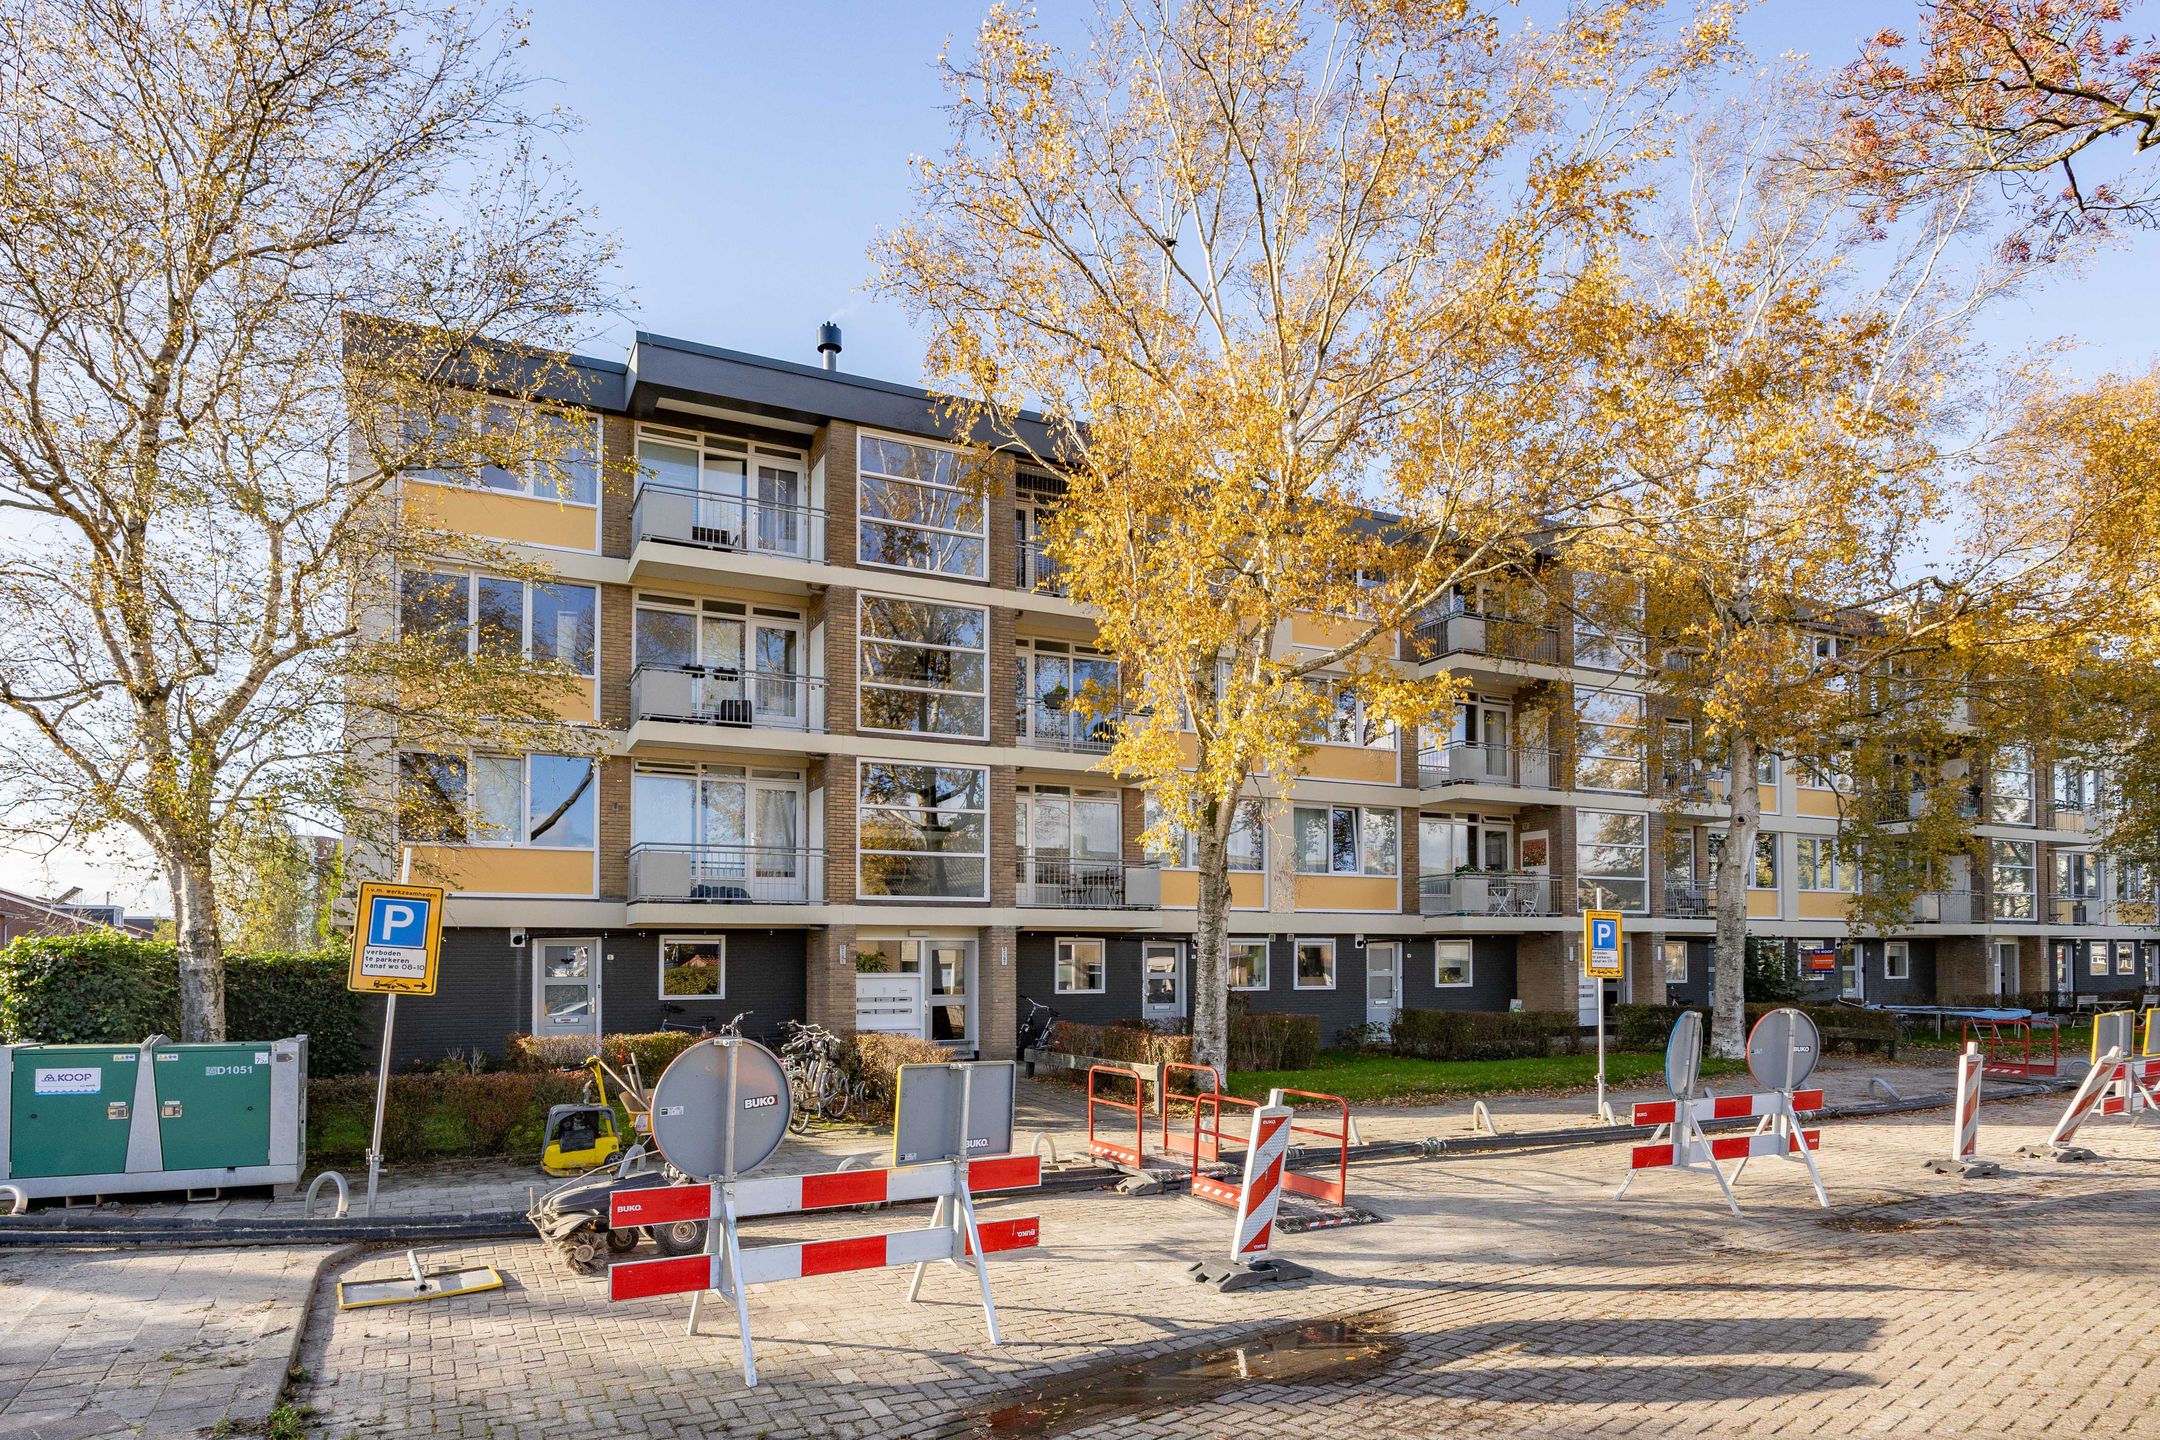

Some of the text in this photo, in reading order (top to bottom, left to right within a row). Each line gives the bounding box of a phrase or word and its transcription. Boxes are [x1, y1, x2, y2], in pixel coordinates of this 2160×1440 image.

[382, 904, 414, 940] P
[1597, 923, 1611, 946] P
[366, 949, 402, 957] verboden
[217, 1065, 253, 1075] D1051
[57, 1073, 92, 1082] KOOP
